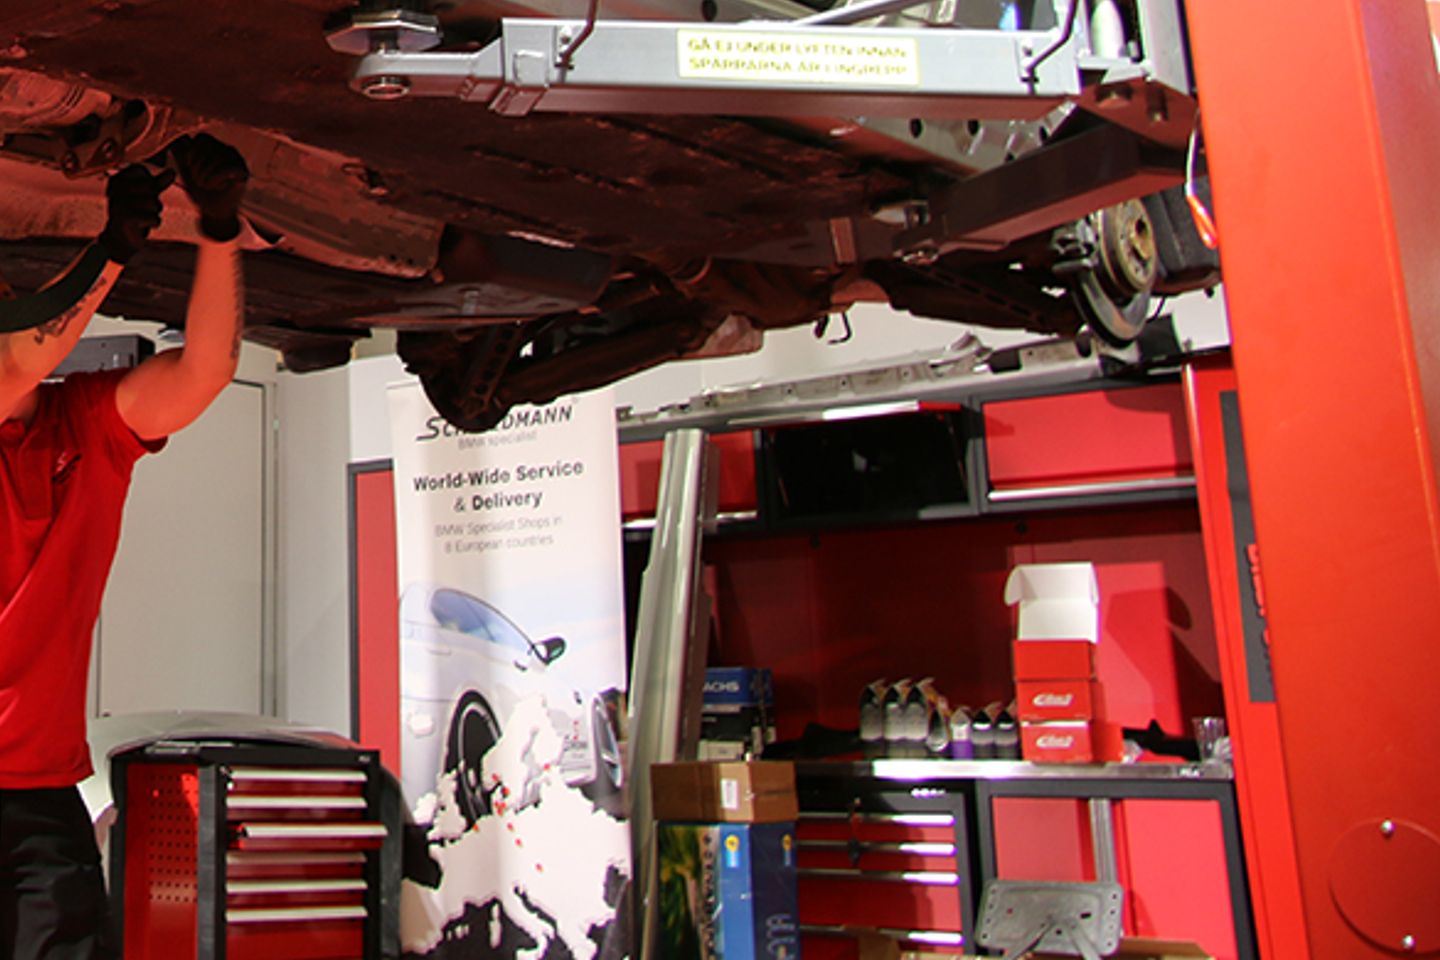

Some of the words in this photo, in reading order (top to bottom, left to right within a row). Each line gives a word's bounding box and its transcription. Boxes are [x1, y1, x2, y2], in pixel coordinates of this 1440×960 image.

[413, 467, 511, 492] World-Wide
[516, 459, 584, 482] Service
[453, 497, 466, 513] &
[472, 490, 544, 512] Delivery
[518, 516, 551, 533] Shops
[703, 681, 739, 693] ACHS
